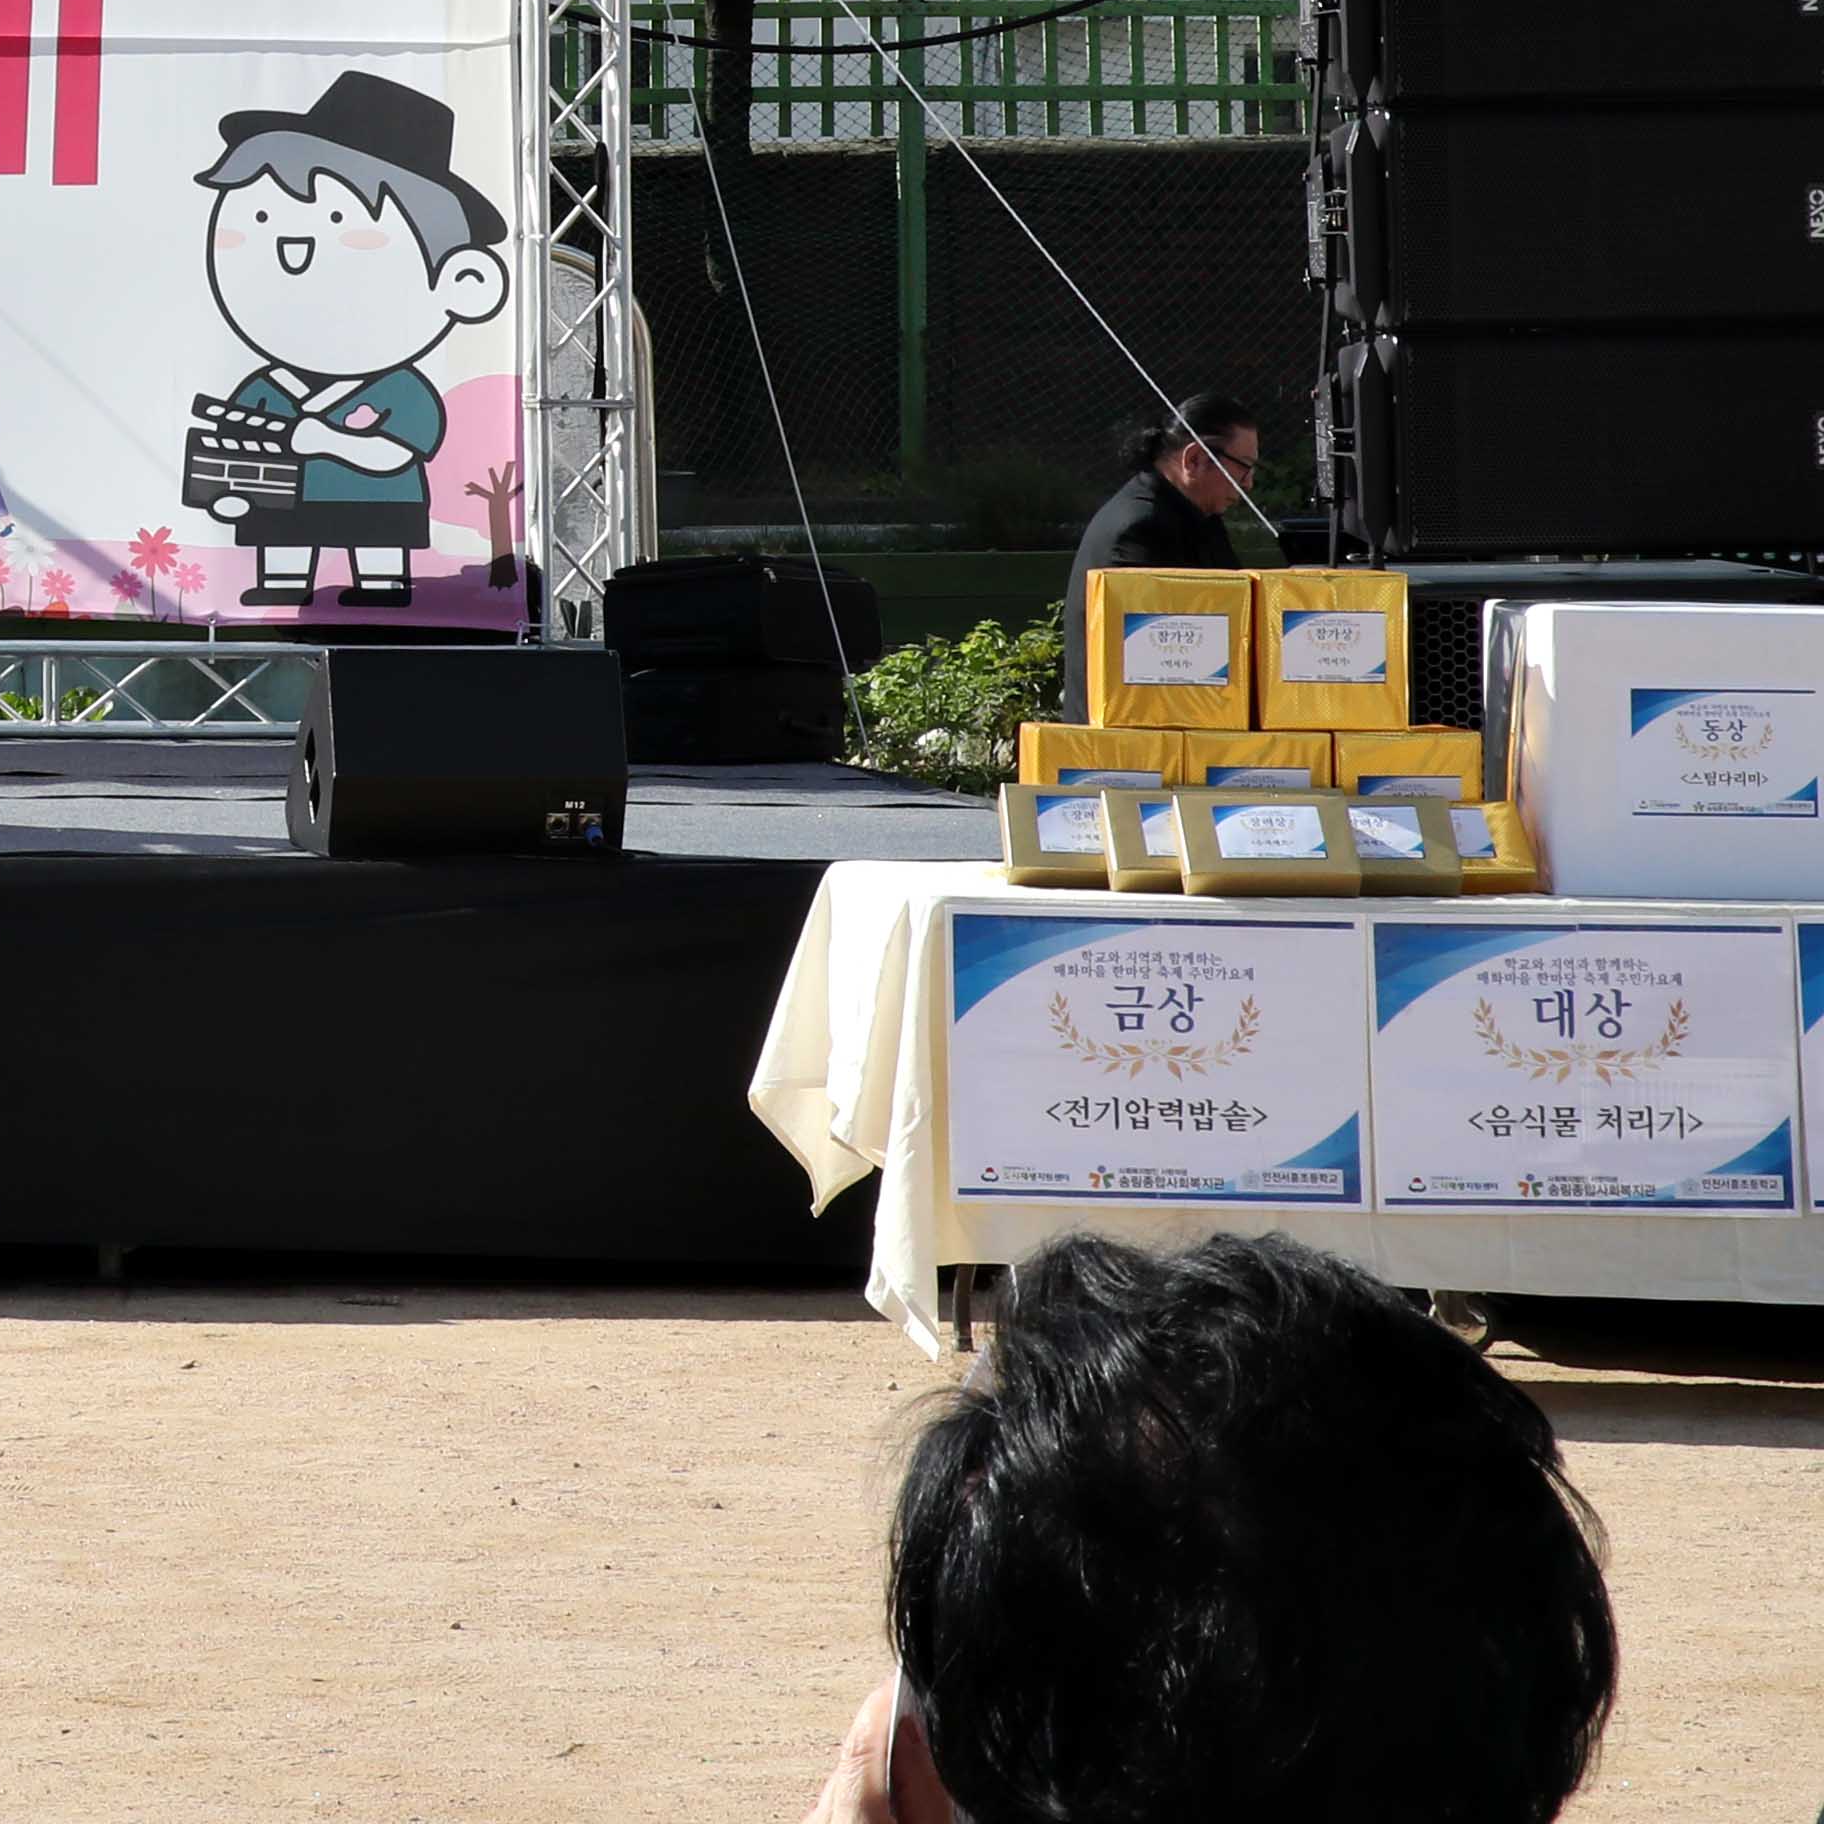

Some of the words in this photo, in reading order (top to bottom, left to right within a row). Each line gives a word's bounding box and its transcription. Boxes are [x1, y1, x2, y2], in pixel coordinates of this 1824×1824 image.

[1701, 718, 1748, 742] 동상
[564, 800, 586, 809] M12
[1081, 950, 1121, 964] 학교와
[1126, 951, 1162, 965] 지역과
[1168, 952, 1223, 966] 함께하는
[1504, 957, 1544, 971] 학교와
[1551, 957, 1589, 971] 지역과
[1595, 957, 1648, 972] 함께하는
[1053, 963, 1105, 978] 매화마을
[1112, 965, 1151, 980] 한마당
[1158, 966, 1183, 980] 축제
[1190, 967, 1255, 981] 주민가요제
[1537, 972, 1577, 986] 한마당
[1584, 972, 1609, 986] 축제
[1616, 972, 1682, 987] 주민가요제
[1105, 983, 1204, 1033] 금상
[1532, 988, 1632, 1039] 대상
[1045, 1096, 1268, 1133] <전기압력밥솥>
[1467, 1104, 1582, 1139] <음식물
[1596, 1105, 1704, 1139] 처리기>
